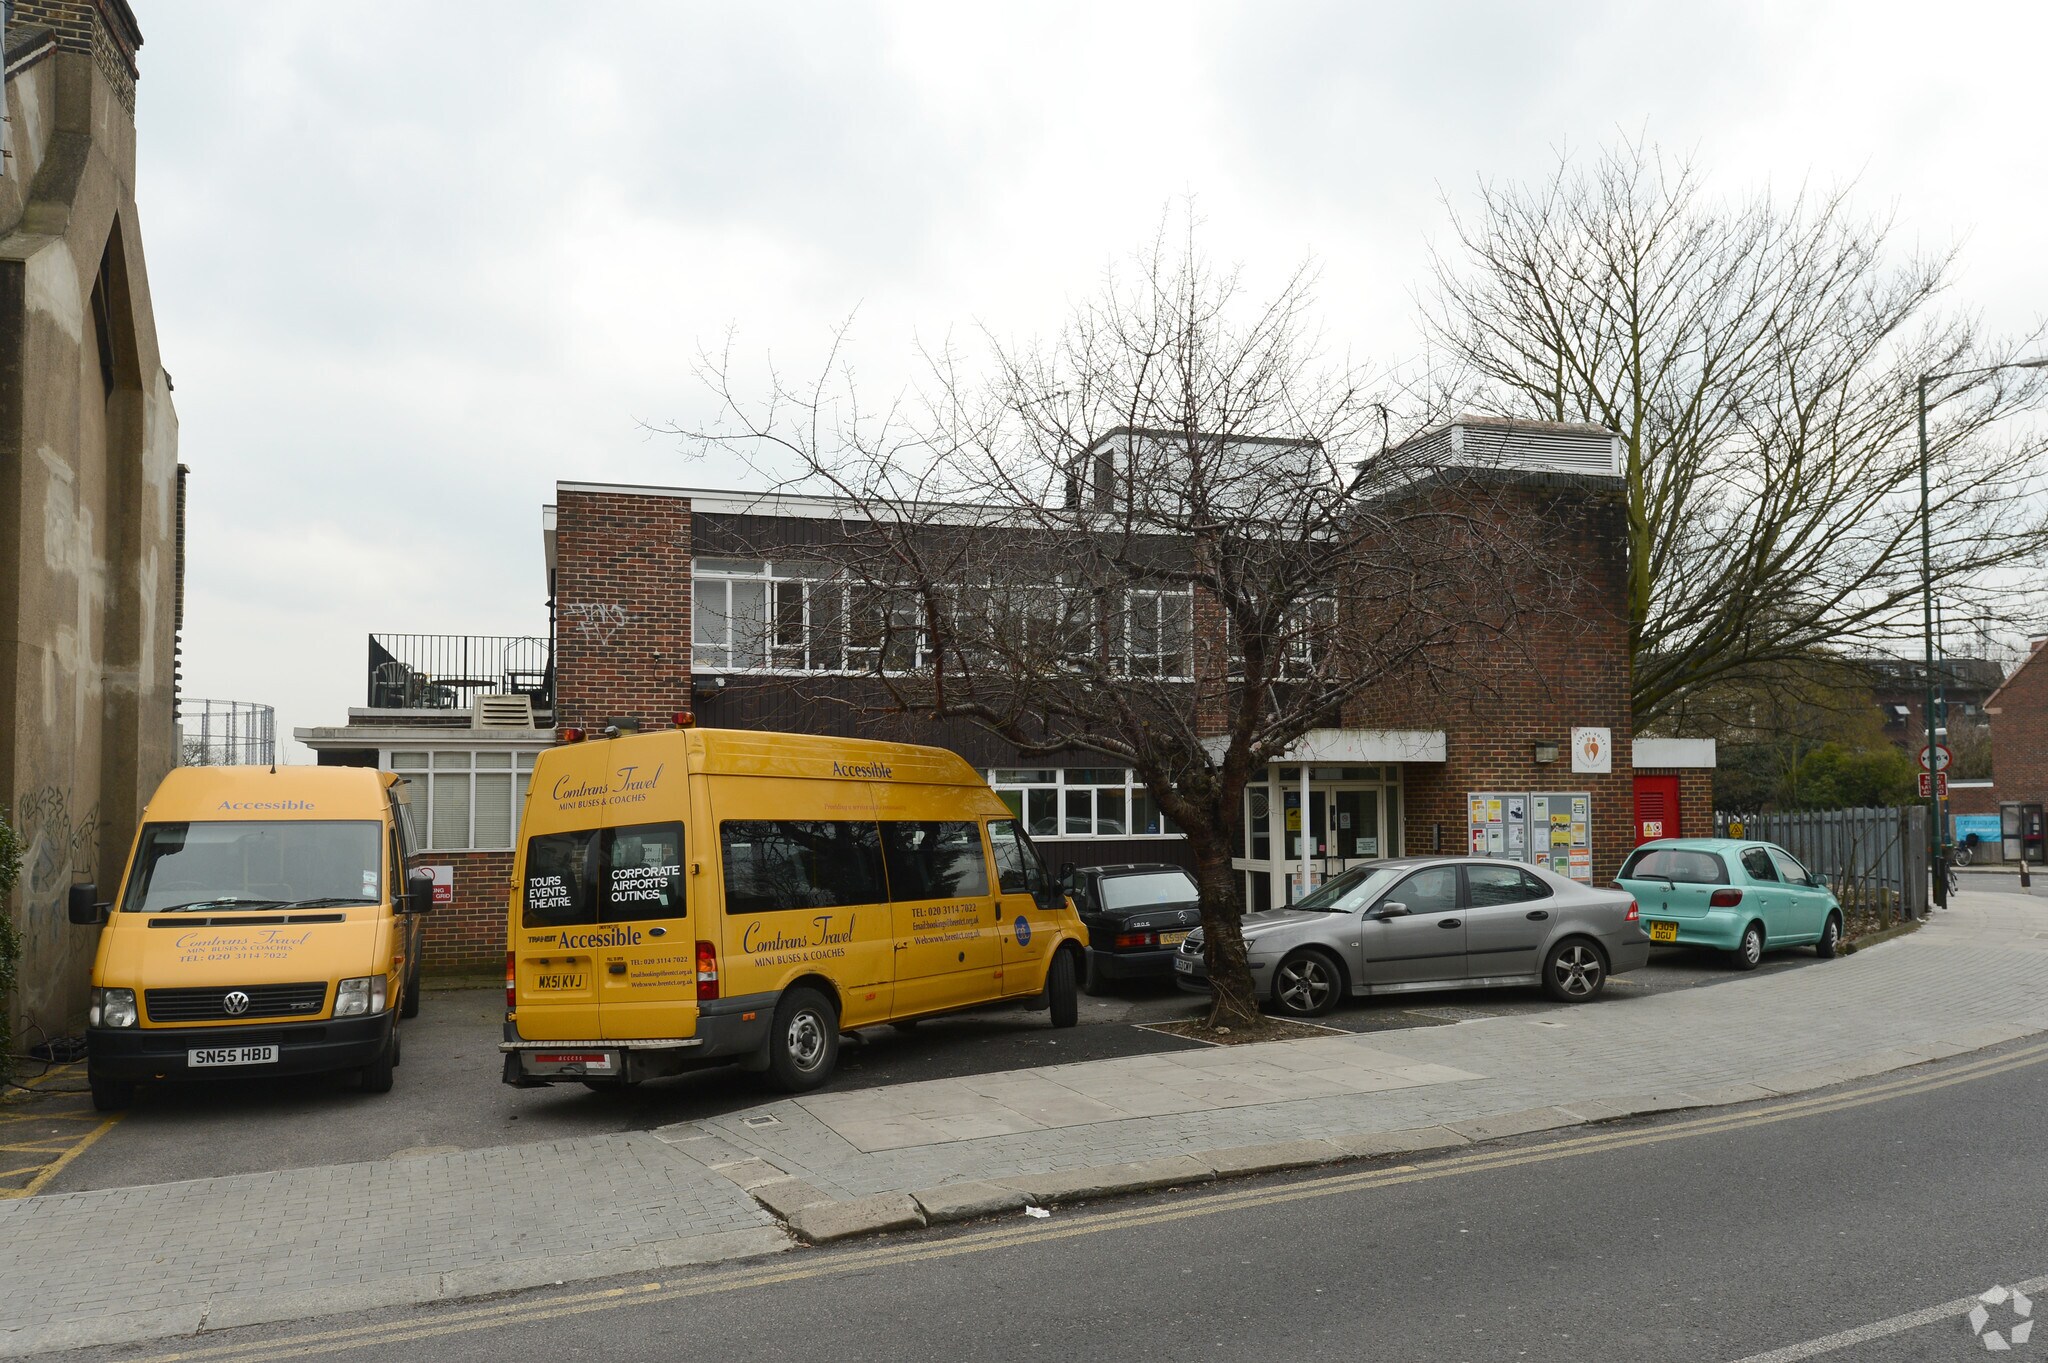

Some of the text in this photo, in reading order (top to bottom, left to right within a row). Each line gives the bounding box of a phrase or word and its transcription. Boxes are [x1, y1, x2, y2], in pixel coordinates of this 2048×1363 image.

[833, 760, 893, 779] Accessible
[553, 763, 664, 800] Comtrans Travel
[218, 800, 315, 811] Accessible
[559, 802, 576, 811] MINI
[578, 798, 600, 808] BUSES
[609, 793, 646, 805] COACHES
[611, 865, 680, 880] CORPORATE
[530, 876, 561, 888] TOURS
[611, 877, 668, 891] AIRPORTS
[530, 886, 567, 898] EVENTS
[611, 889, 660, 902] OUTINGS
[530, 896, 571, 909] THEATRE
[912, 903, 977, 917] TEL: 020 3114 7022
[1653, 921, 1675, 931] W309
[176, 929, 312, 949] Comtrans Travel
[559, 925, 642, 949] Accessible
[743, 913, 856, 954] Comtrans Travel
[1655, 931, 1672, 940] DGU
[180, 955, 204, 963] TEL:
[755, 957, 775, 967] MINI
[777, 953, 801, 965] BUSES
[811, 948, 845, 960] COACHES
[539, 974, 582, 989] MX51 KVJ
[196, 1047, 272, 1064] SN55 HBD
